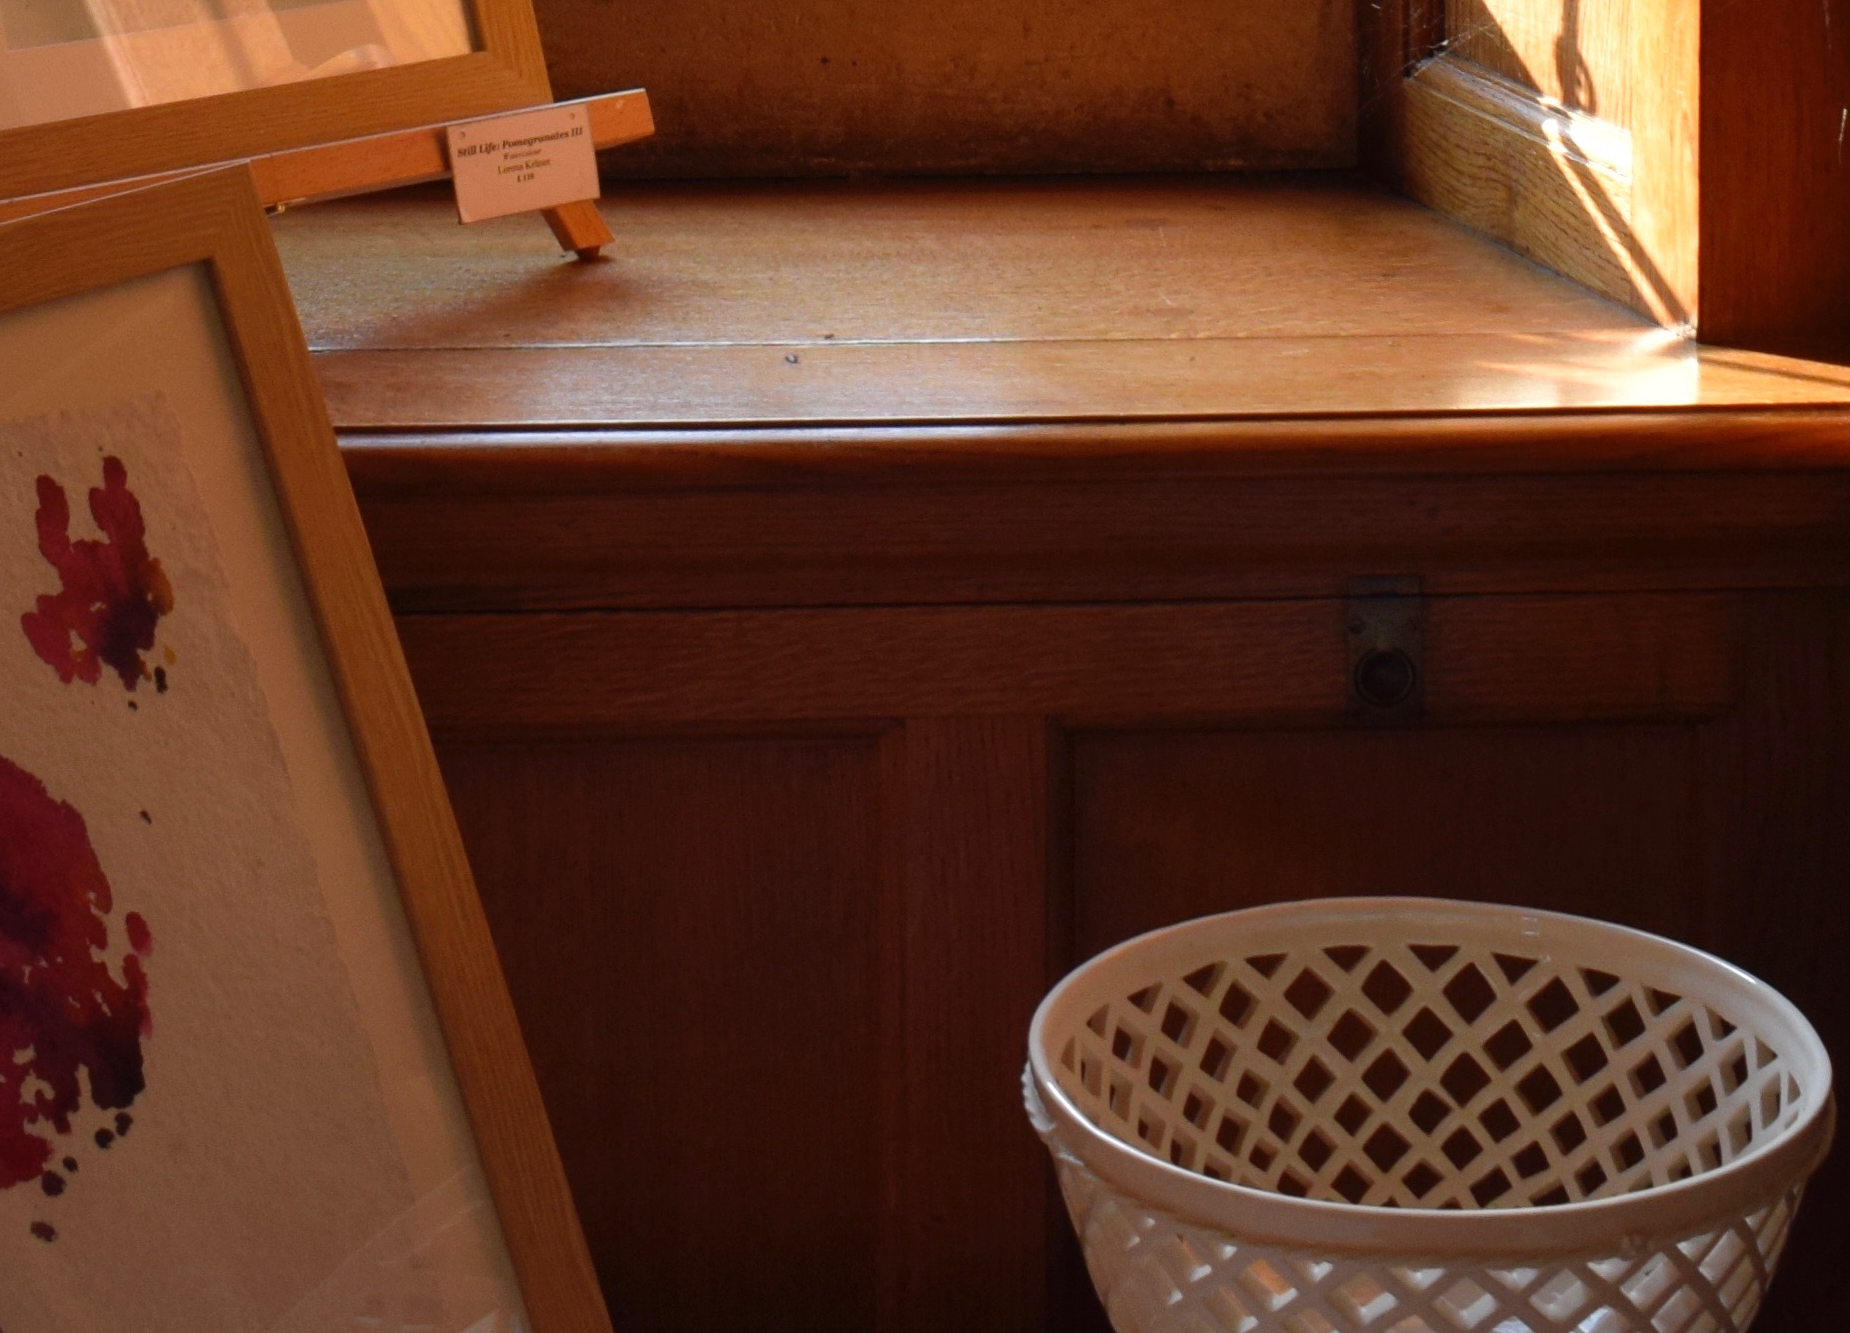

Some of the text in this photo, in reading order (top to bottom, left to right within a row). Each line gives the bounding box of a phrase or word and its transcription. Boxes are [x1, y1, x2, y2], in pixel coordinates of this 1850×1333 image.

[457, 145, 477, 157] Still
[479, 142, 499, 154] Life:
[502, 130, 569, 149] Pomegranates
